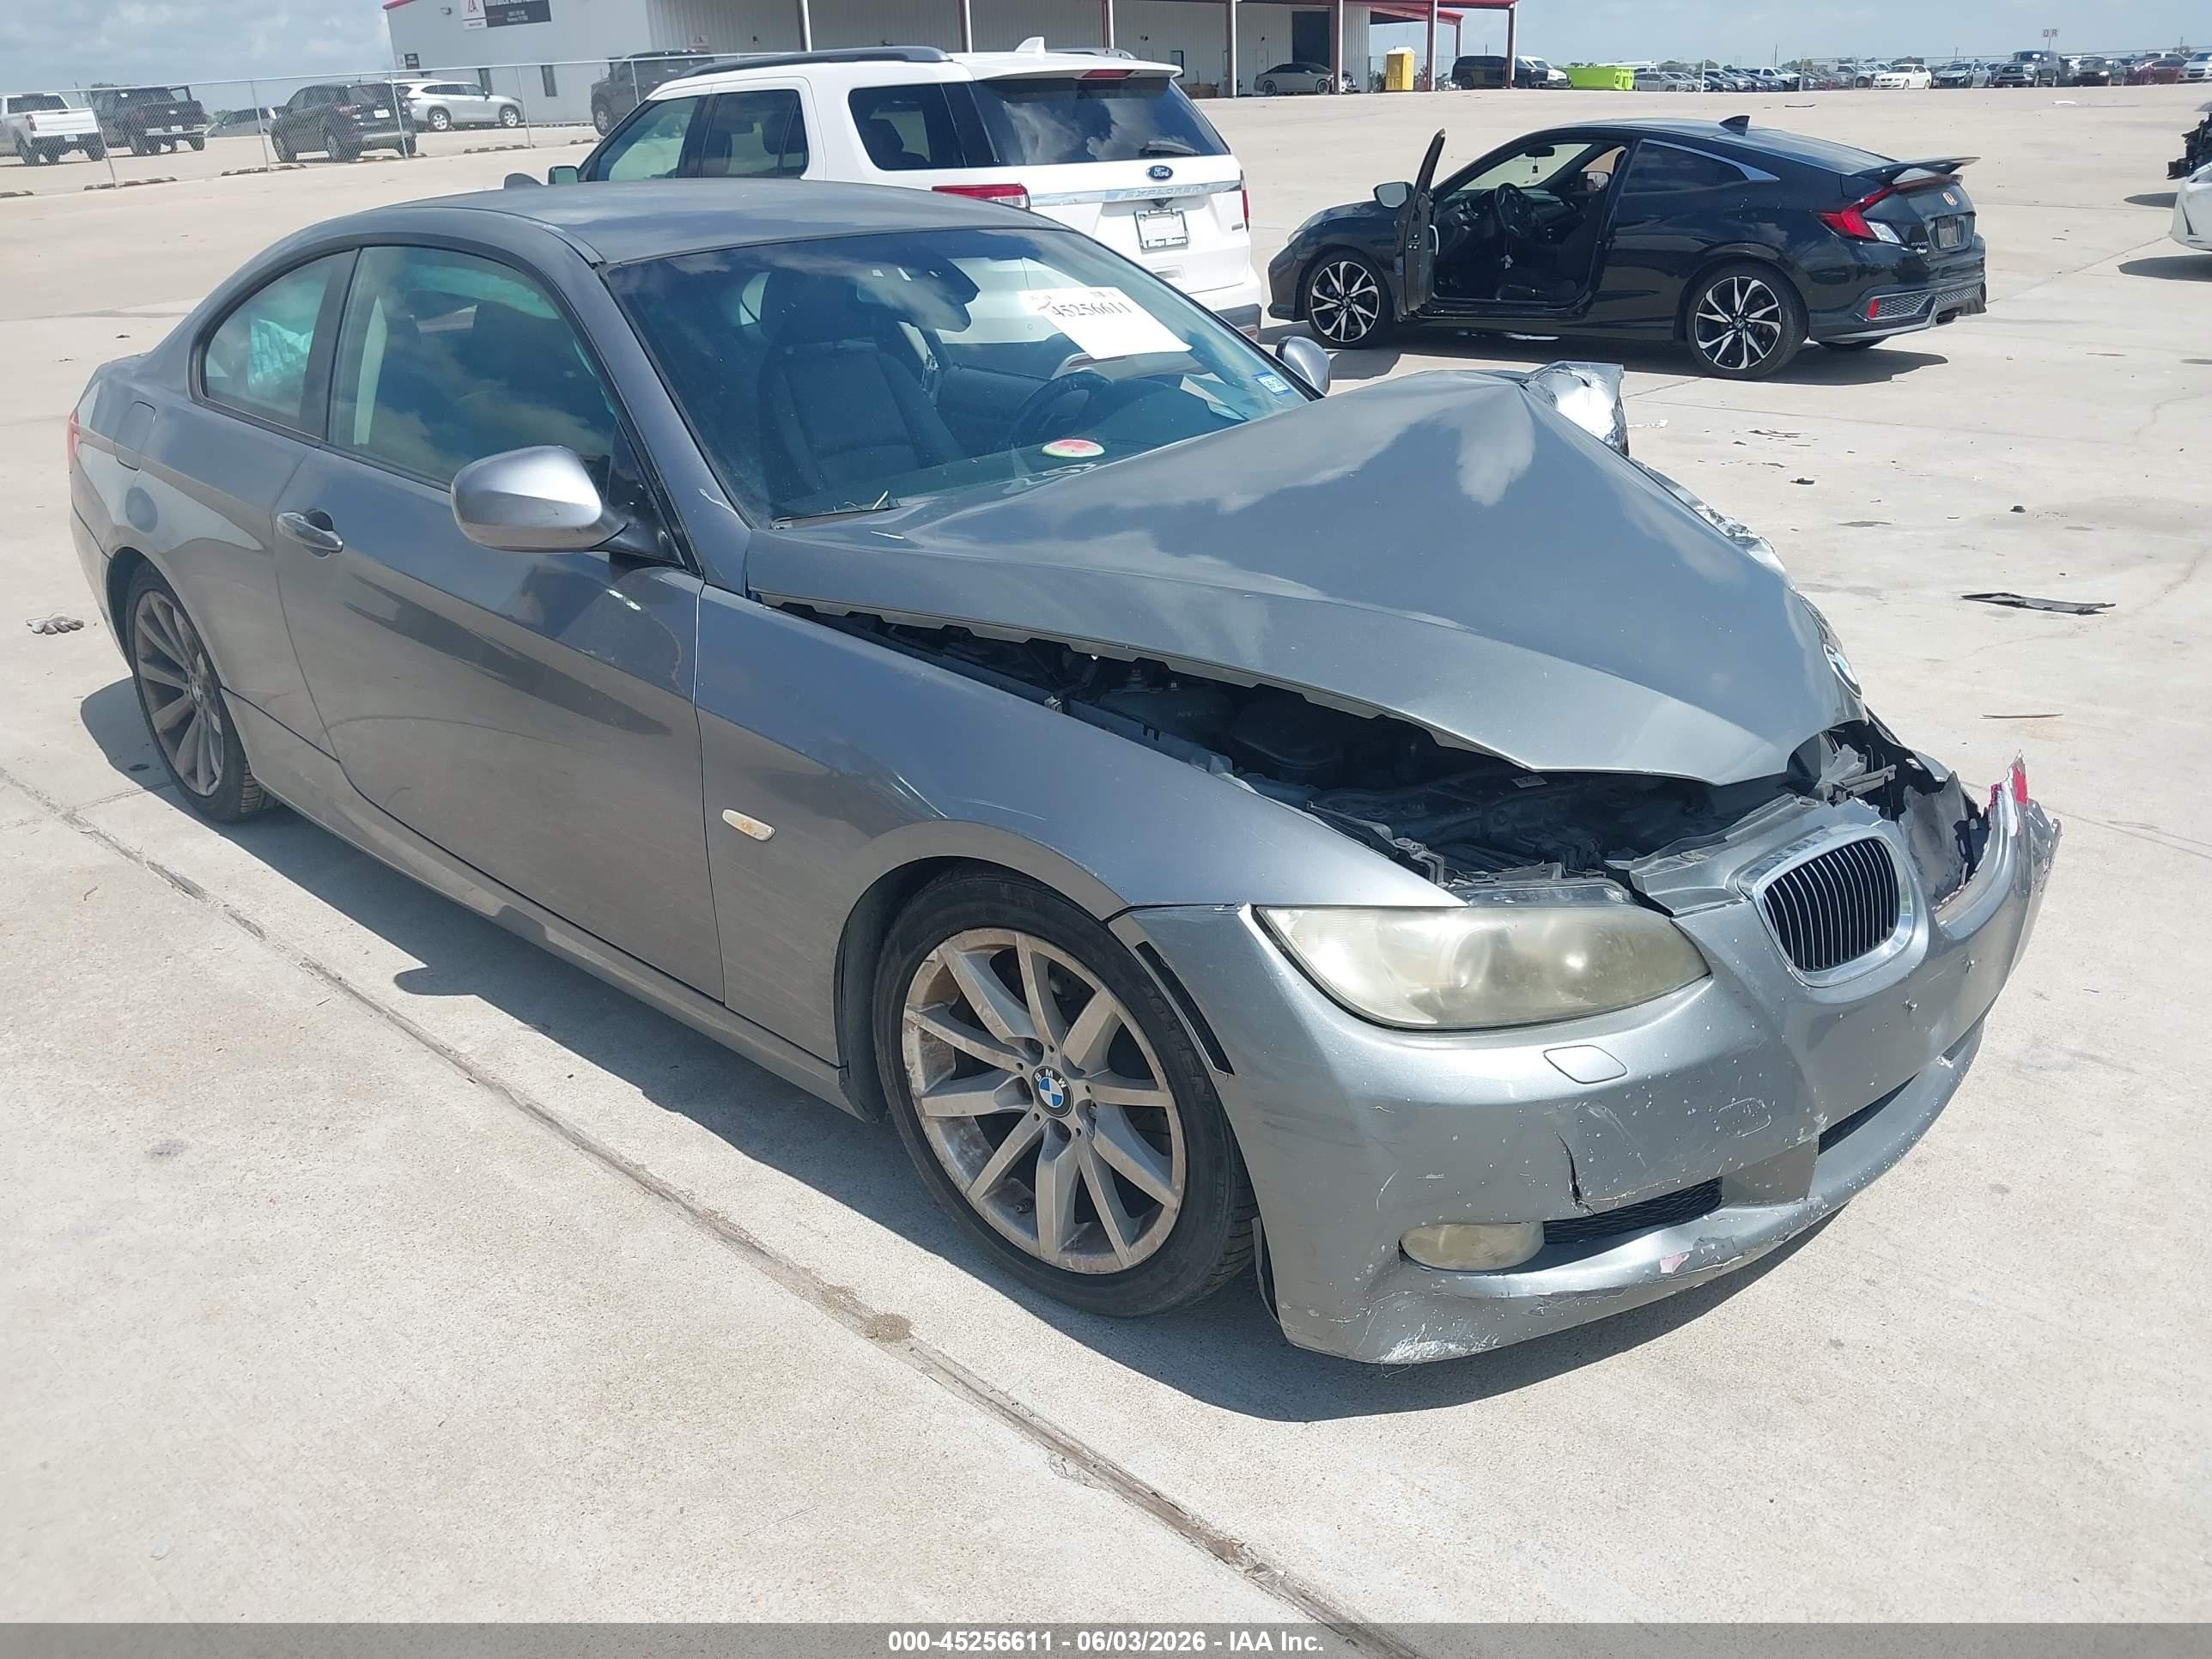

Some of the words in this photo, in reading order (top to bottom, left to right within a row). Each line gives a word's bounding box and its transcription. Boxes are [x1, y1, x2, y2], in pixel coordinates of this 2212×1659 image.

[1153, 167, 1170, 177] Ford
[1126, 185, 1202, 198] EXPLORER
[1034, 1068, 1067, 1089] BMW
